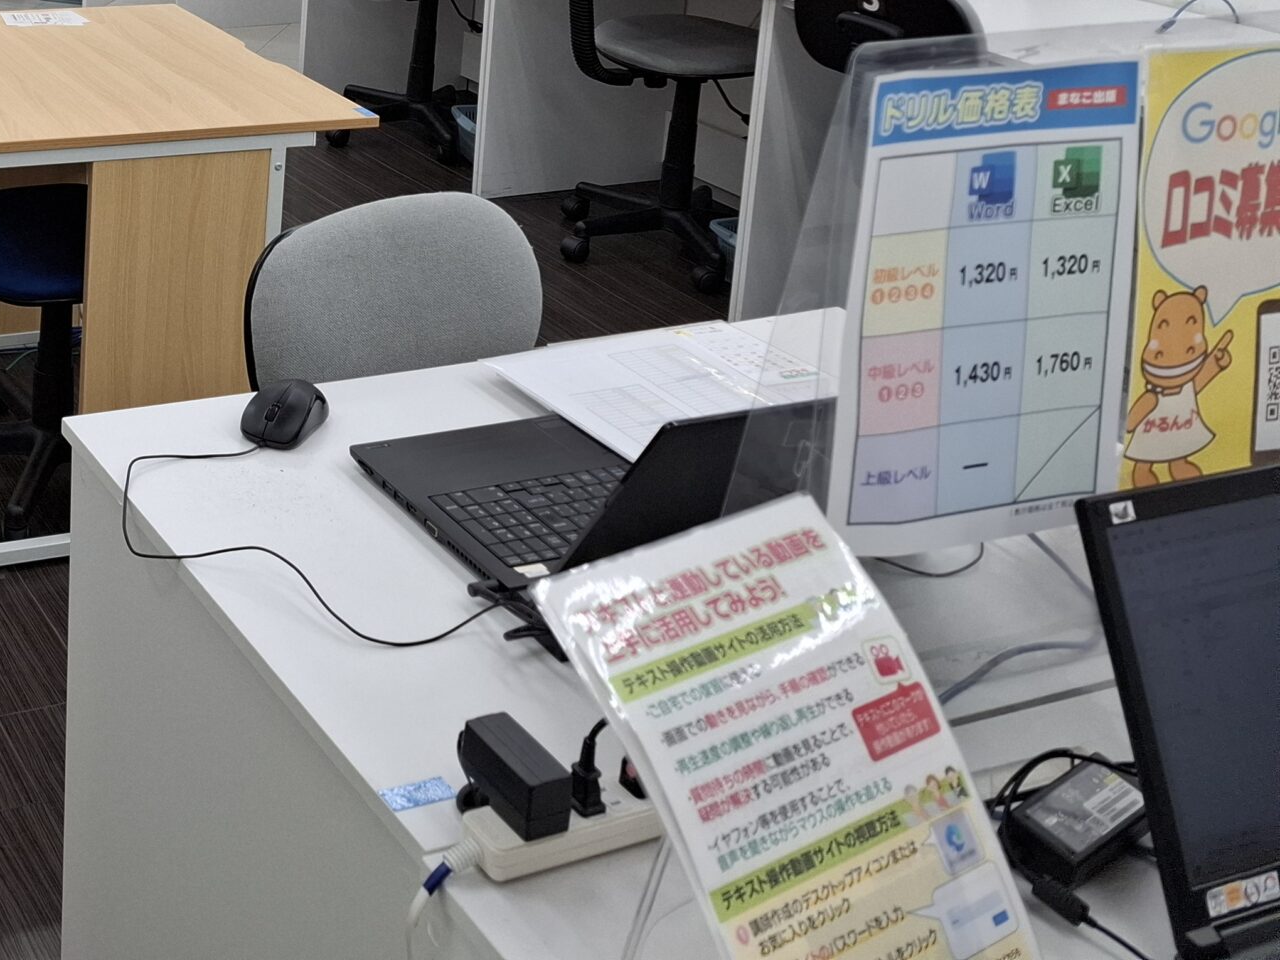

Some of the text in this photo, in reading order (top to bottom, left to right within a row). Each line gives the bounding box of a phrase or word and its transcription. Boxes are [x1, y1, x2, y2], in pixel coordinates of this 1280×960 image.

[881, 84, 1117, 134] ドリル価格表 まなこ出版
[1181, 101, 1280, 149] Goog
[968, 200, 1015, 220] Word
[1051, 195, 1101, 214] Excel
[873, 263, 940, 284] 初級レベル
[867, 361, 935, 382] 中級レベル
[860, 465, 931, 487] 上級レベル
